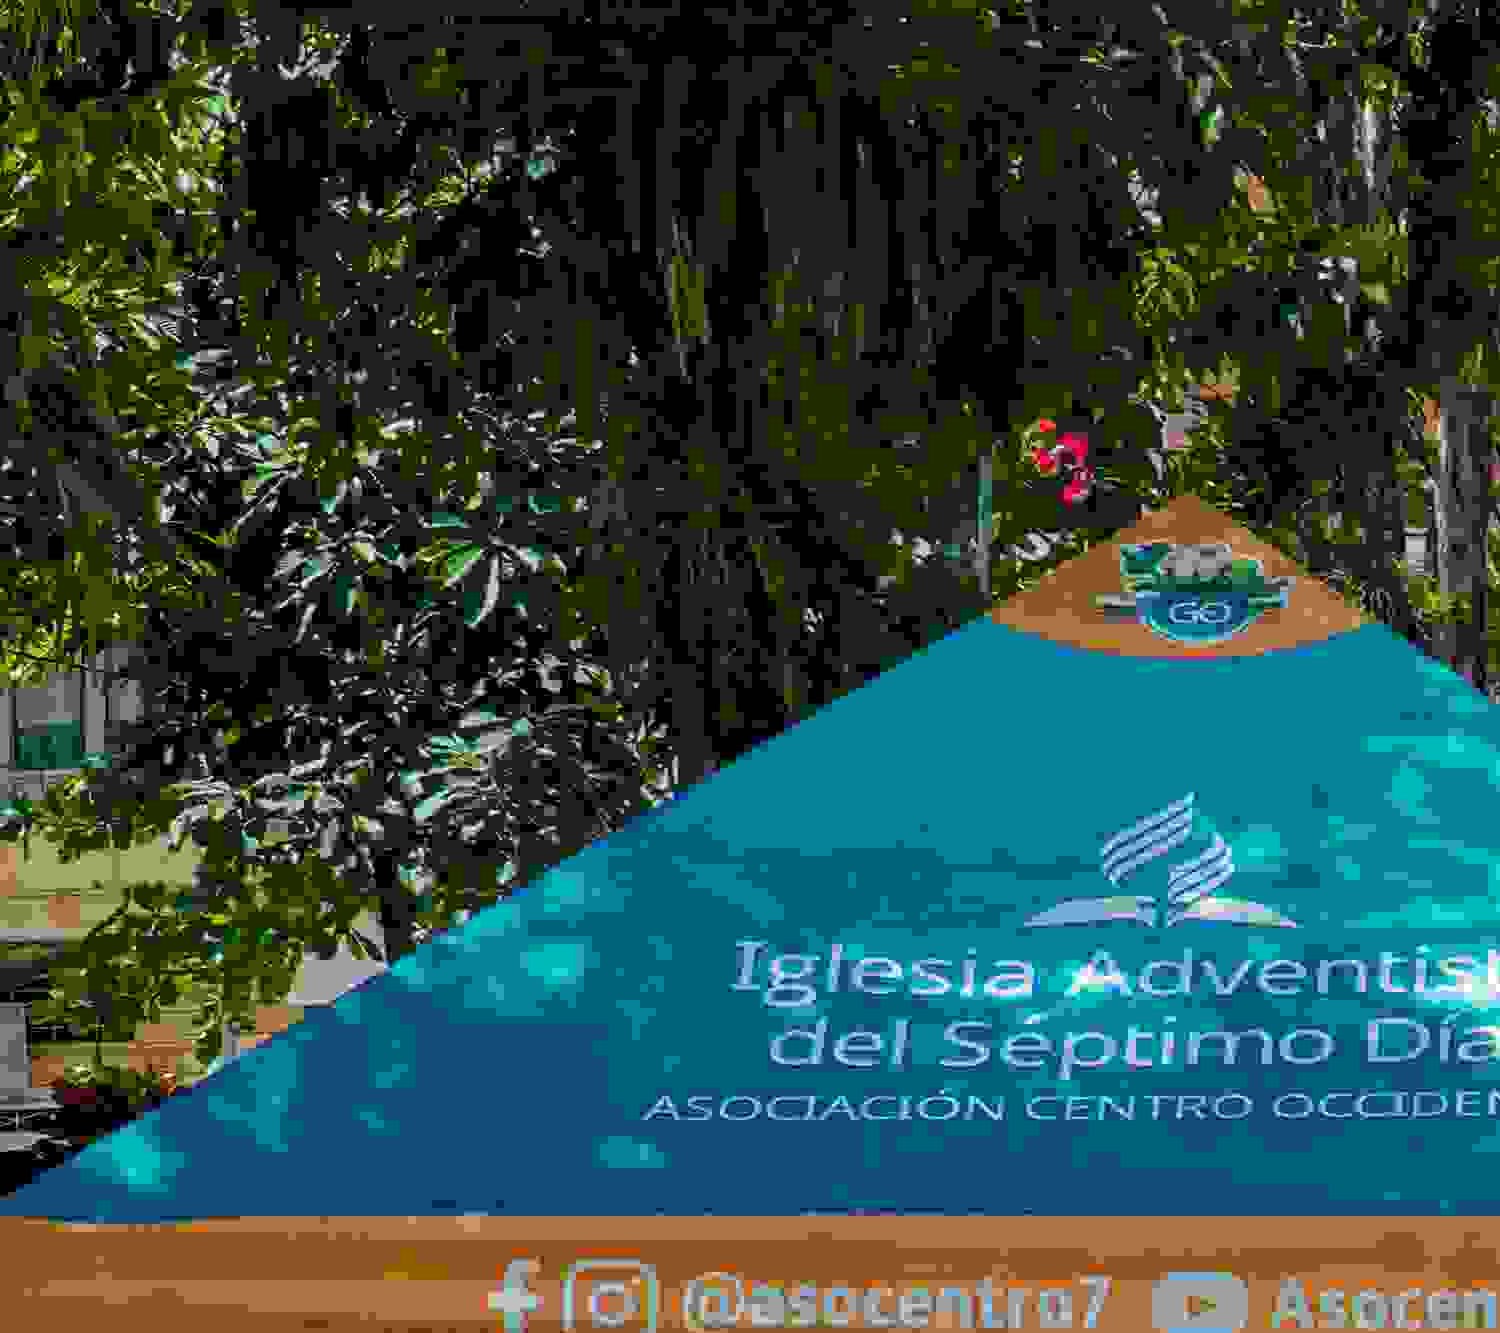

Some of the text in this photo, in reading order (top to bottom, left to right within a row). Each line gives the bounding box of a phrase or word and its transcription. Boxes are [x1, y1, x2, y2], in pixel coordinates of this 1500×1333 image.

[1167, 599, 1233, 625] GO
[731, 940, 1036, 1008] Iglesia
[767, 1015, 909, 1070] del
[940, 1009, 1335, 1079] Séptimo
[641, 1087, 1005, 1122] ASOCIACIÓN
[1024, 1092, 1253, 1122] CENTRO
